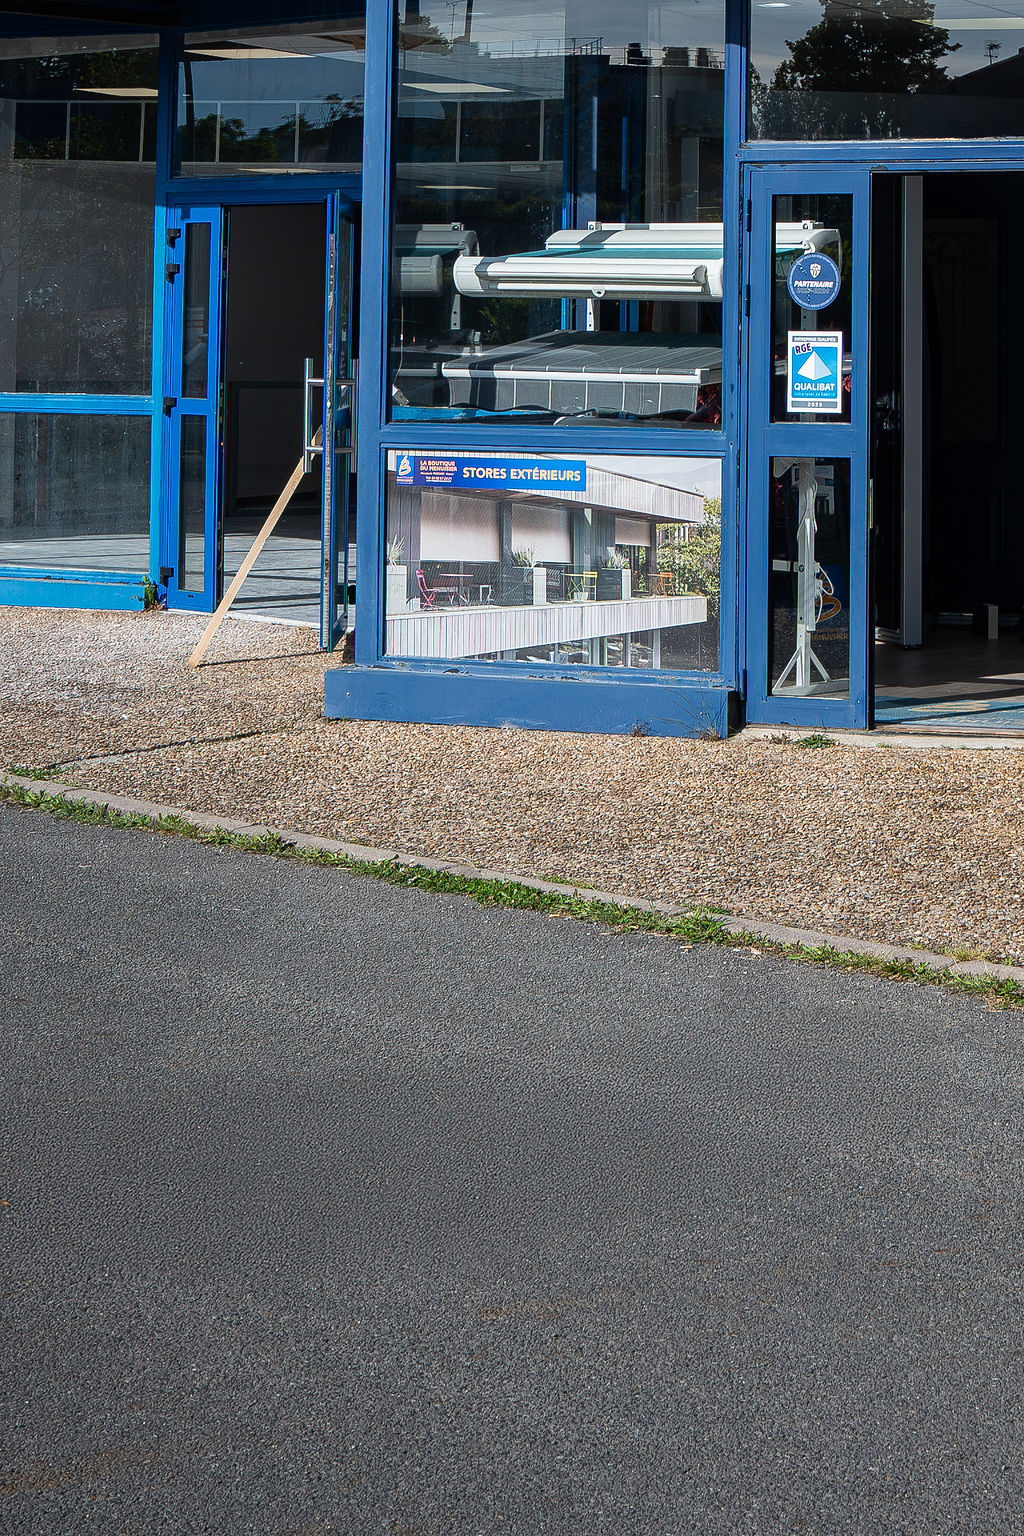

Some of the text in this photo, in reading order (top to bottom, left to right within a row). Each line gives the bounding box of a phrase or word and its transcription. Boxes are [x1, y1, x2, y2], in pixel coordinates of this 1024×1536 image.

[793, 280, 834, 288] PARTENAIRE
[795, 343, 812, 354] RGE
[794, 382, 836, 392] QUALIBAT
[462, 467, 507, 480] STORES
[510, 466, 581, 482] EXTÉRIEURS
